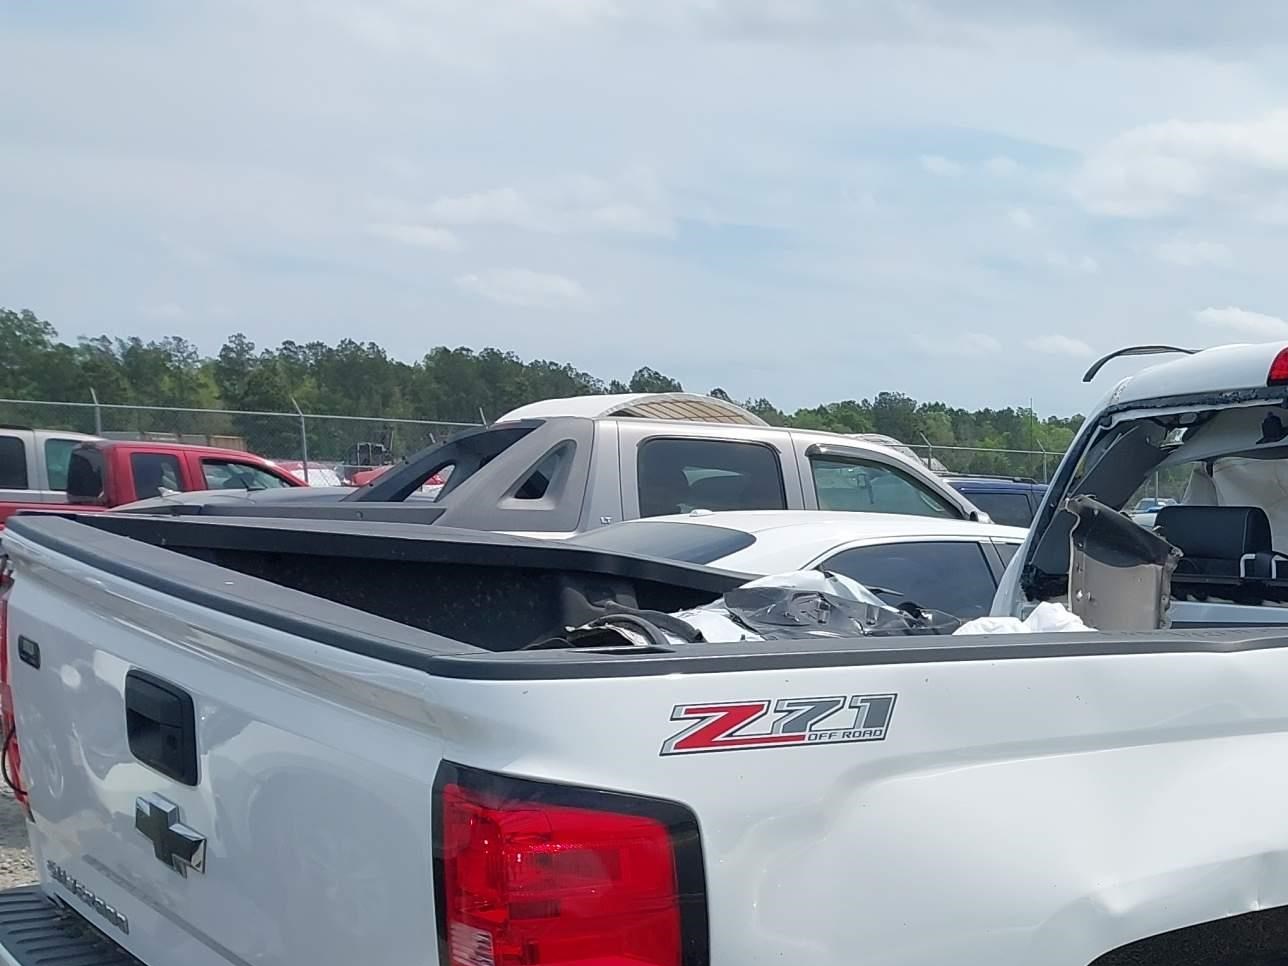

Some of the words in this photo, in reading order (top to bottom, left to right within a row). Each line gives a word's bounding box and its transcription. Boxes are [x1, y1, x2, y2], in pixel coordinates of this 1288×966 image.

[659, 693, 897, 757] Z71
[807, 731, 838, 741] OFF
[841, 728, 883, 739] ROAD
